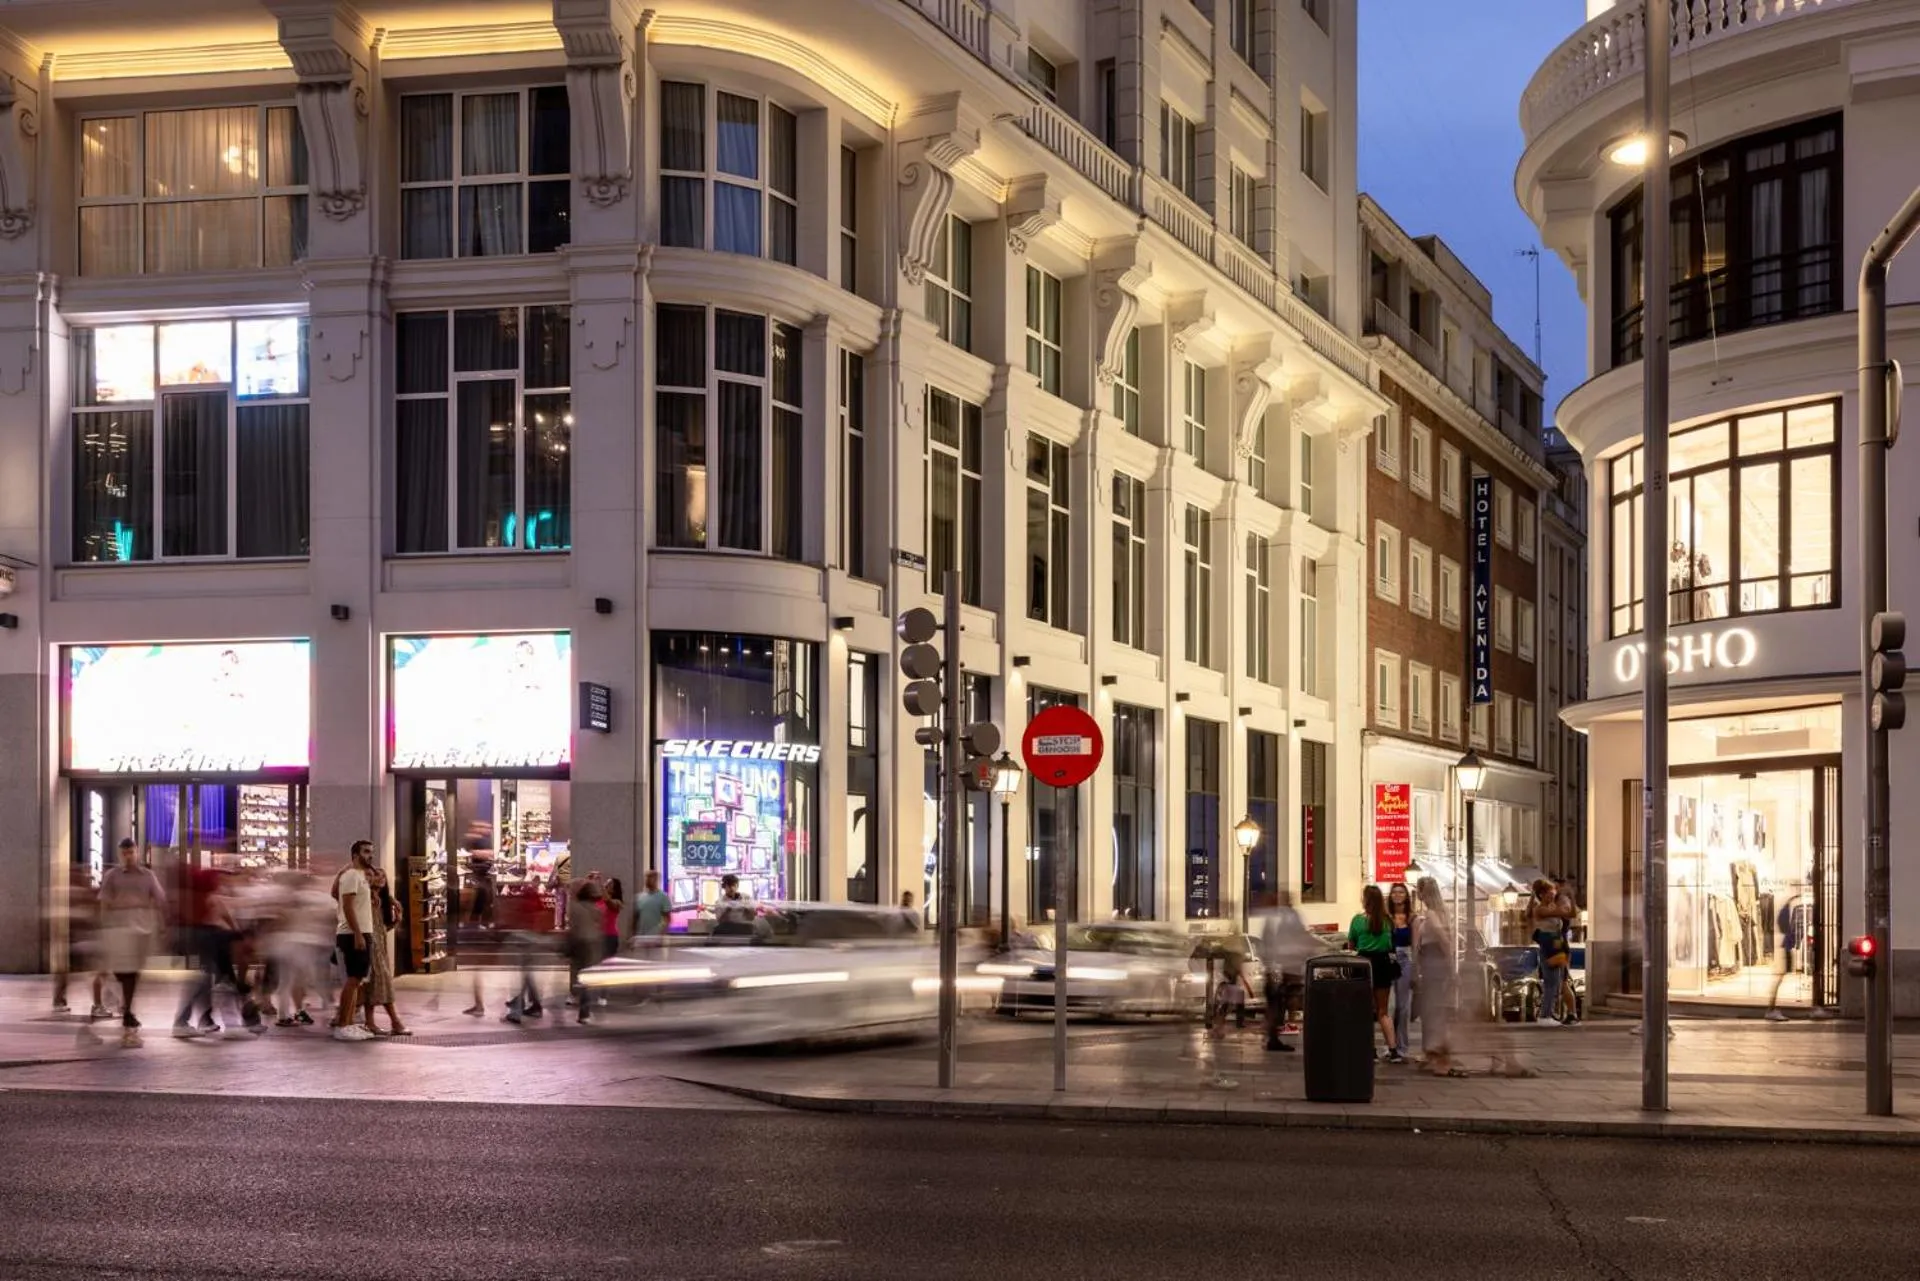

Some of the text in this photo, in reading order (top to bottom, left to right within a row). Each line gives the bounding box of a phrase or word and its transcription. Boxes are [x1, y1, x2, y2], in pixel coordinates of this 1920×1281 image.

[1476, 483, 1489, 698] HOTEL AVENIDA
[1615, 627, 1757, 682] OSHO
[662, 740, 821, 762] SKECHERS
[669, 761, 781, 799] THE UNO
[687, 844, 722, 860] 30%
